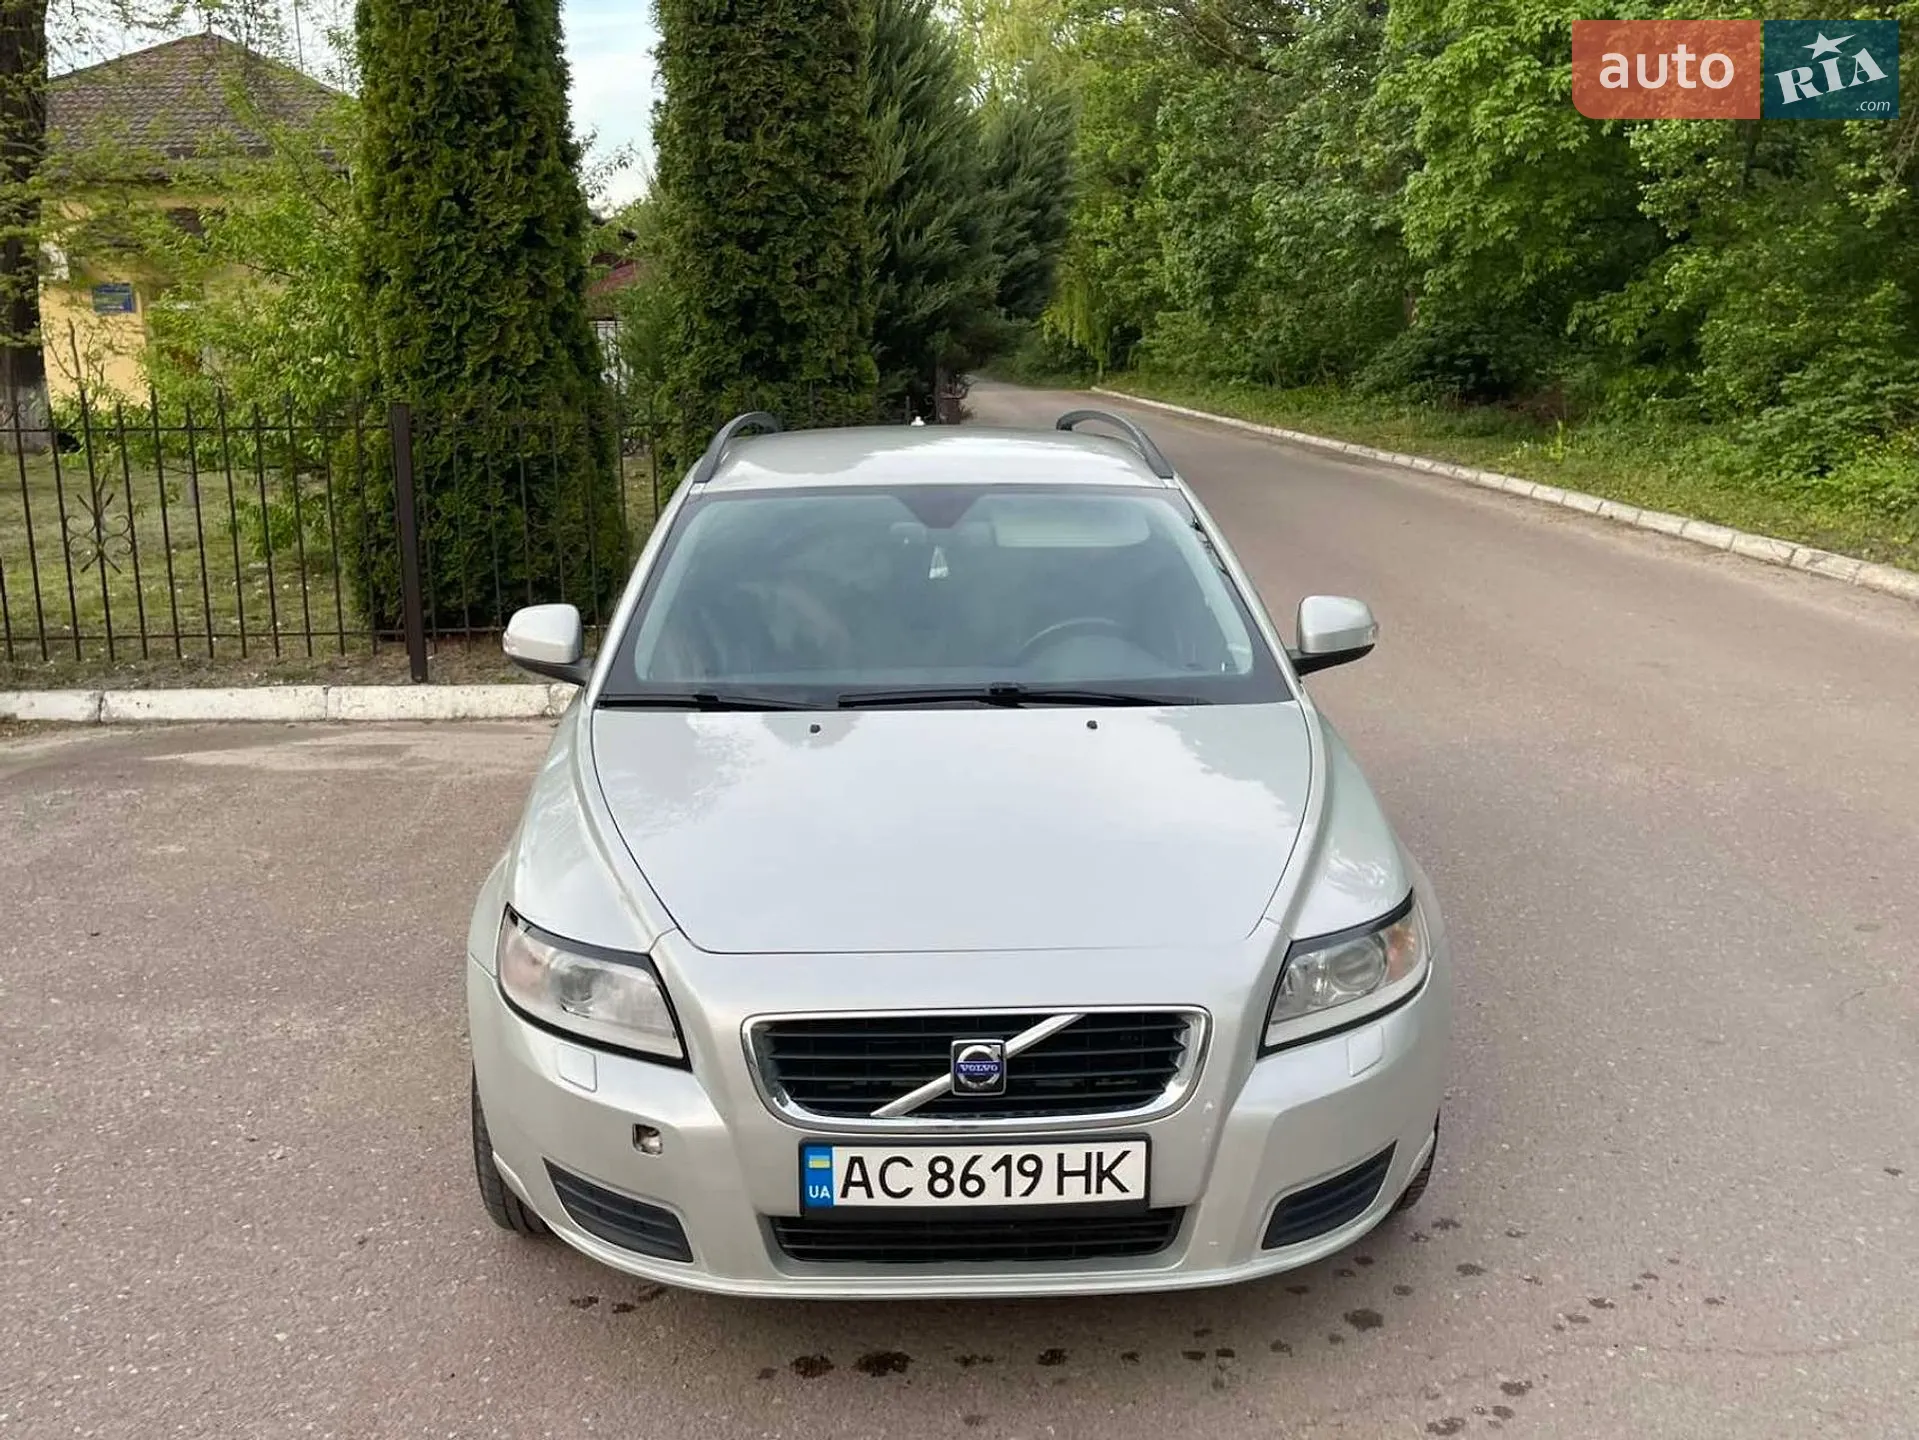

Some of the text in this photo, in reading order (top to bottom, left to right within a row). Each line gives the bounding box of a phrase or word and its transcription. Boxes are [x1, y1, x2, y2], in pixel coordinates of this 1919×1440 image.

[960, 1064, 998, 1072] VOLVO
[840, 1149, 1132, 1200] AC 8619 HK
[809, 1185, 831, 1199] UA
